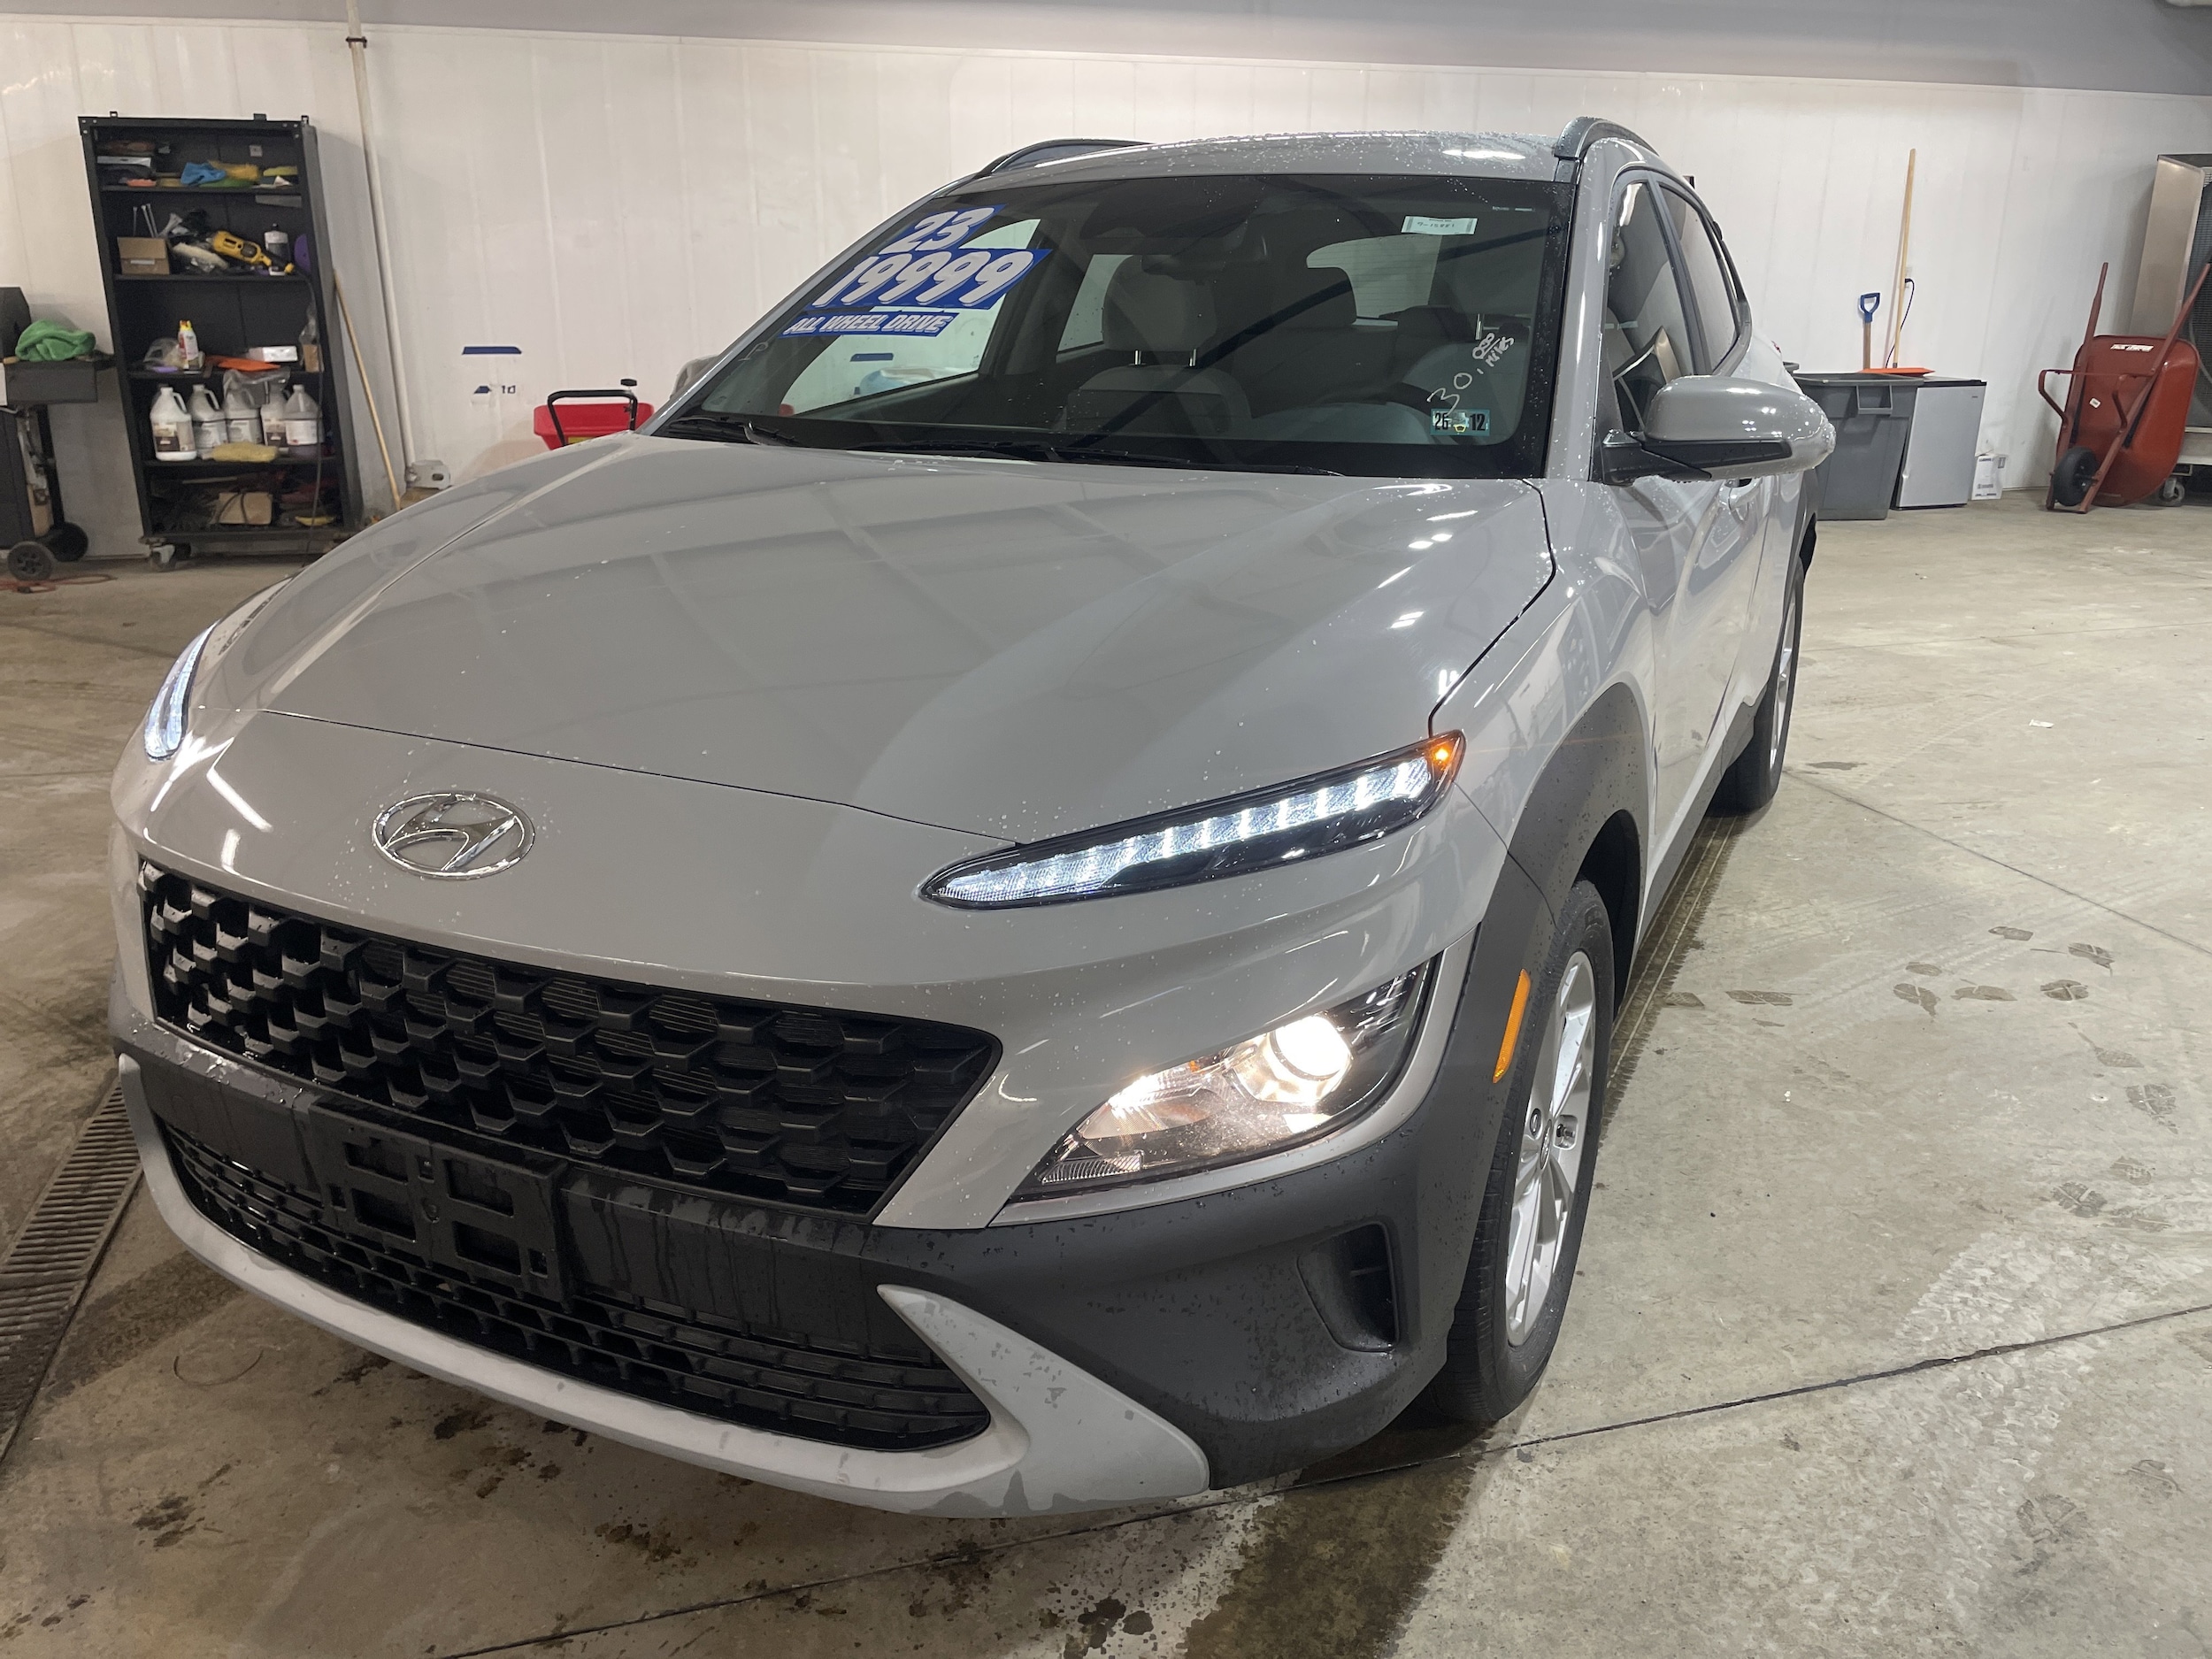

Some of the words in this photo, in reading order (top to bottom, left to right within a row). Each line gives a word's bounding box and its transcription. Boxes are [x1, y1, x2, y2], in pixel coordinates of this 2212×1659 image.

[879, 207, 995, 255] 23
[811, 250, 1034, 307] 19999
[783, 317, 826, 334] ALL
[819, 315, 888, 333] WHEEL
[881, 315, 955, 334] DRIVE
[1470, 413, 1486, 431] 12
